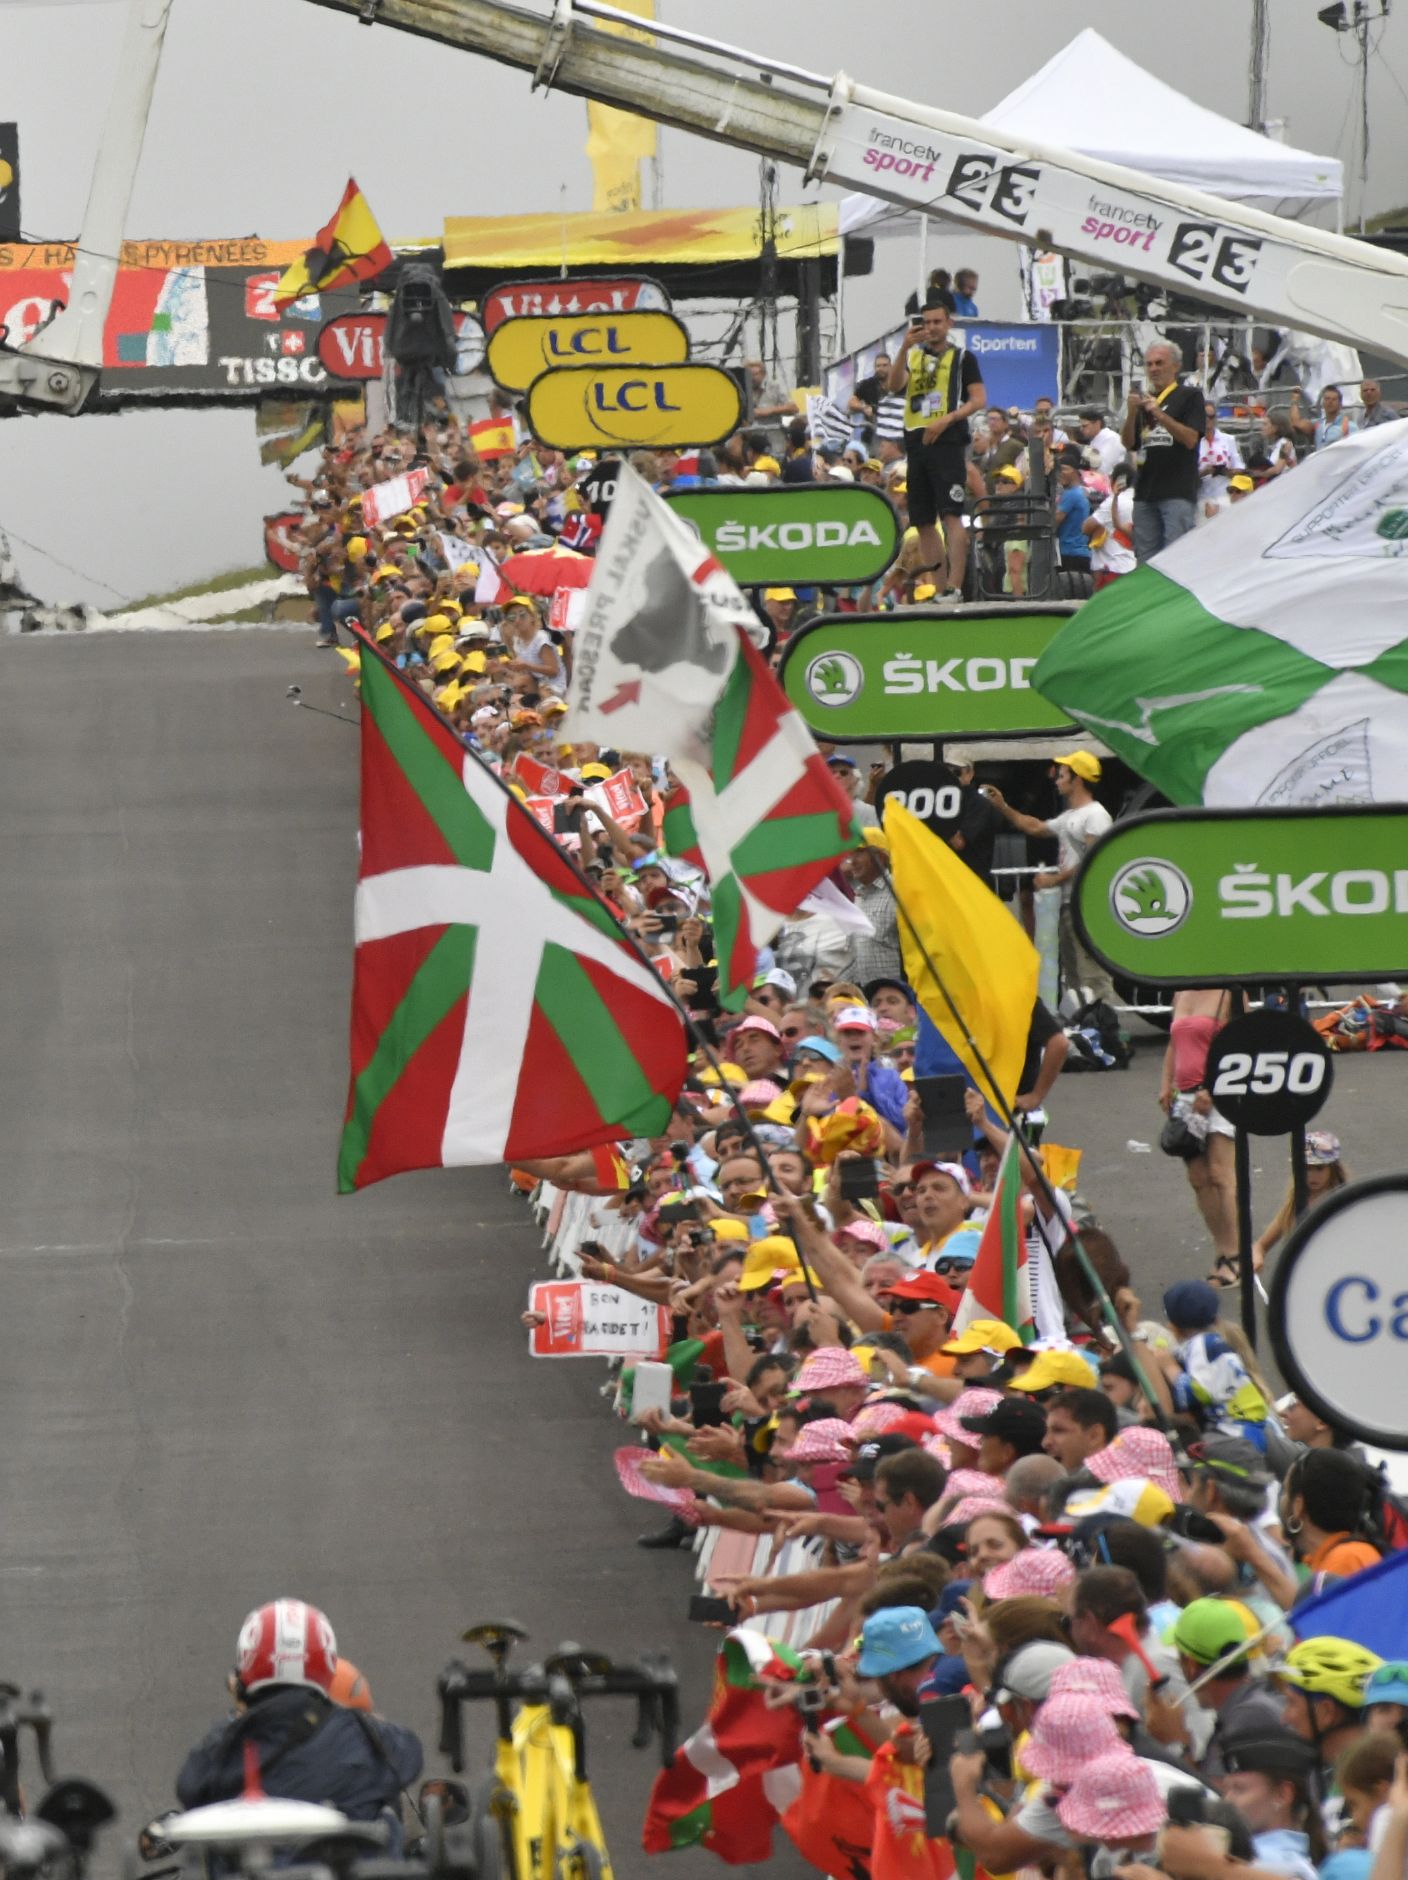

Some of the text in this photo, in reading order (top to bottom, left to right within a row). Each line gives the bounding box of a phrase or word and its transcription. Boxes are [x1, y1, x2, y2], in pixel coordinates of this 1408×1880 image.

[868, 127, 942, 162] francetv
[863, 148, 936, 182] sport
[1088, 194, 1163, 231] francetv
[1081, 216, 1156, 252] sport
[549, 327, 632, 357] LCL
[218, 356, 328, 386] TISSO
[594, 380, 681, 412] LCL
[585, 477, 618, 503] 10
[715, 519, 881, 553] ŠKODA
[883, 652, 1038, 695] ŠKOD
[1218, 863, 1408, 921] ŠKO
[1213, 1051, 1327, 1096] 250
